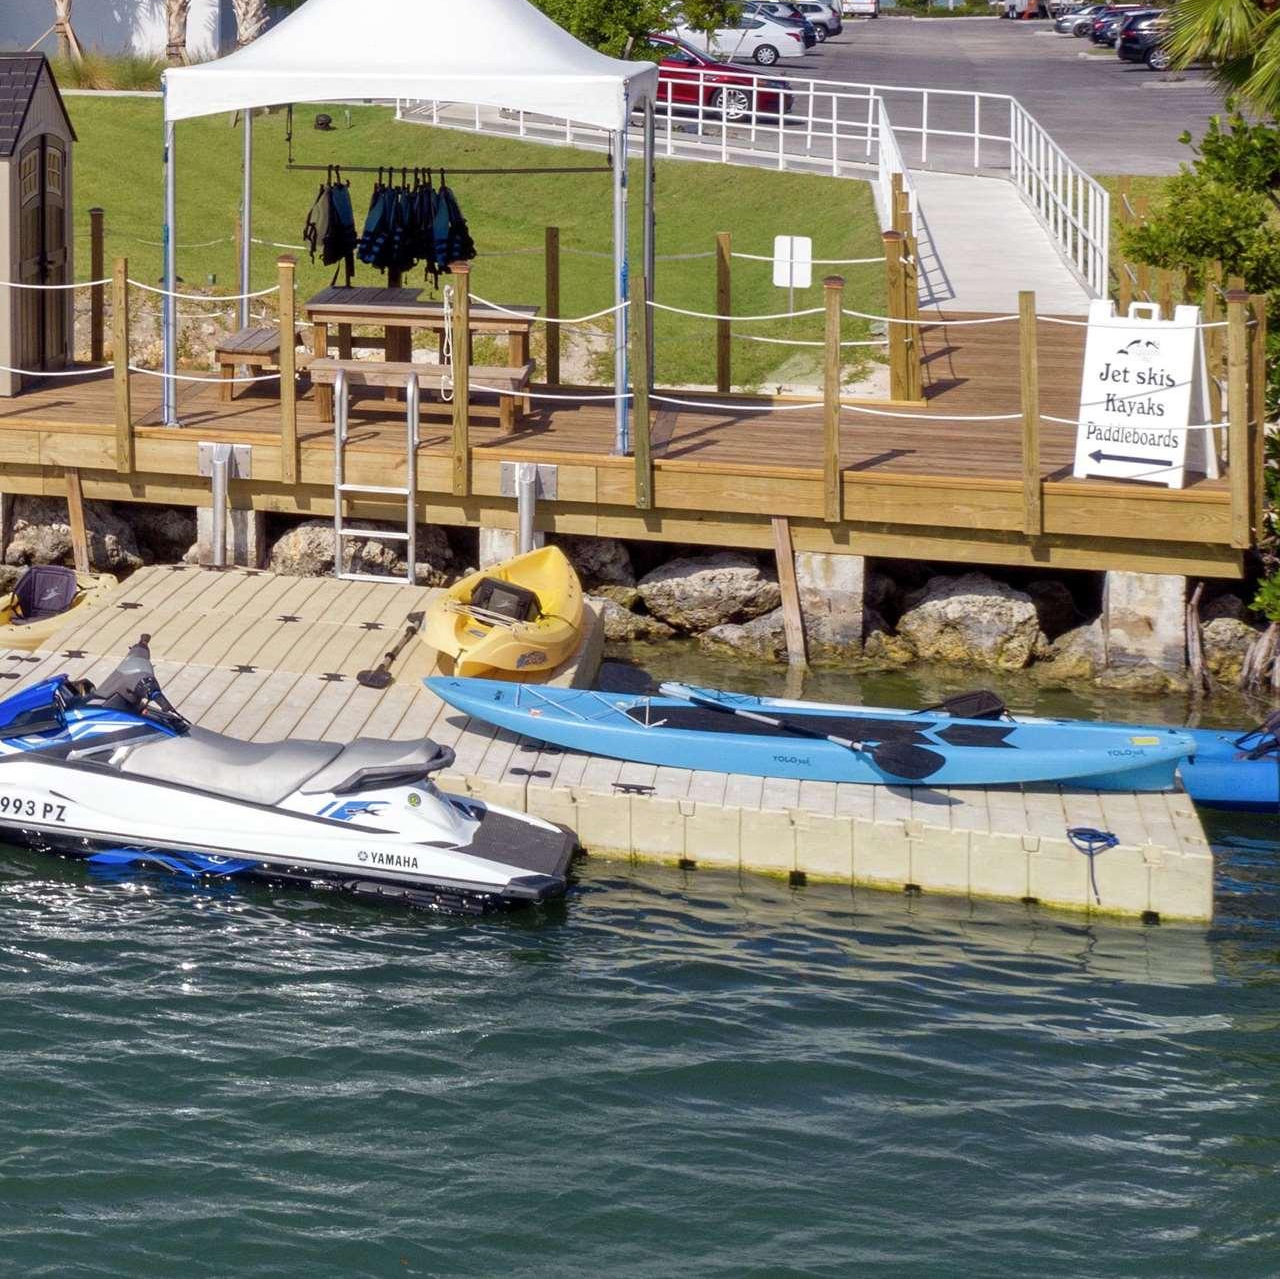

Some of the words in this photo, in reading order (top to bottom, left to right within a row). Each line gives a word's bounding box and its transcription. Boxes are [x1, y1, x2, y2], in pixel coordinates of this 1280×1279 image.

[1099, 363, 1130, 383] Jet
[1136, 367, 1176, 388] skis
[1105, 393, 1165, 417] Kayaks
[1087, 421, 1179, 449] Paddleboards
[42, 803, 66, 822] PZ
[371, 851, 418, 869] YAMAHA
